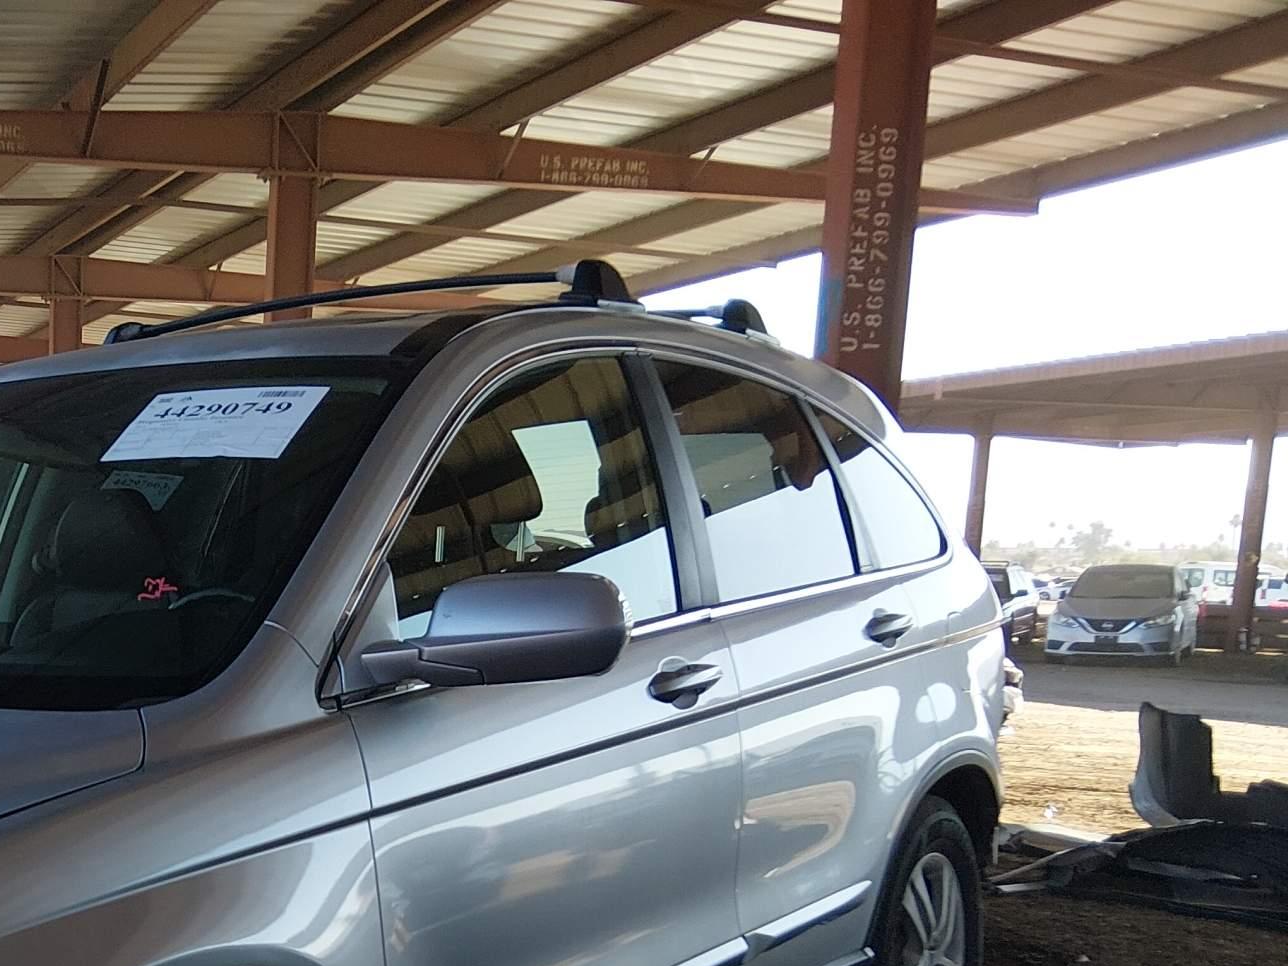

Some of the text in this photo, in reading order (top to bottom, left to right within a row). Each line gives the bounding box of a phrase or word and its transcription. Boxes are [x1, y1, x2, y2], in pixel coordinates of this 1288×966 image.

[841, 124, 878, 353] U.S. PREFAB INC.
[862, 127, 899, 351] 1-866-799-0969
[154, 401, 294, 419] 44290749
